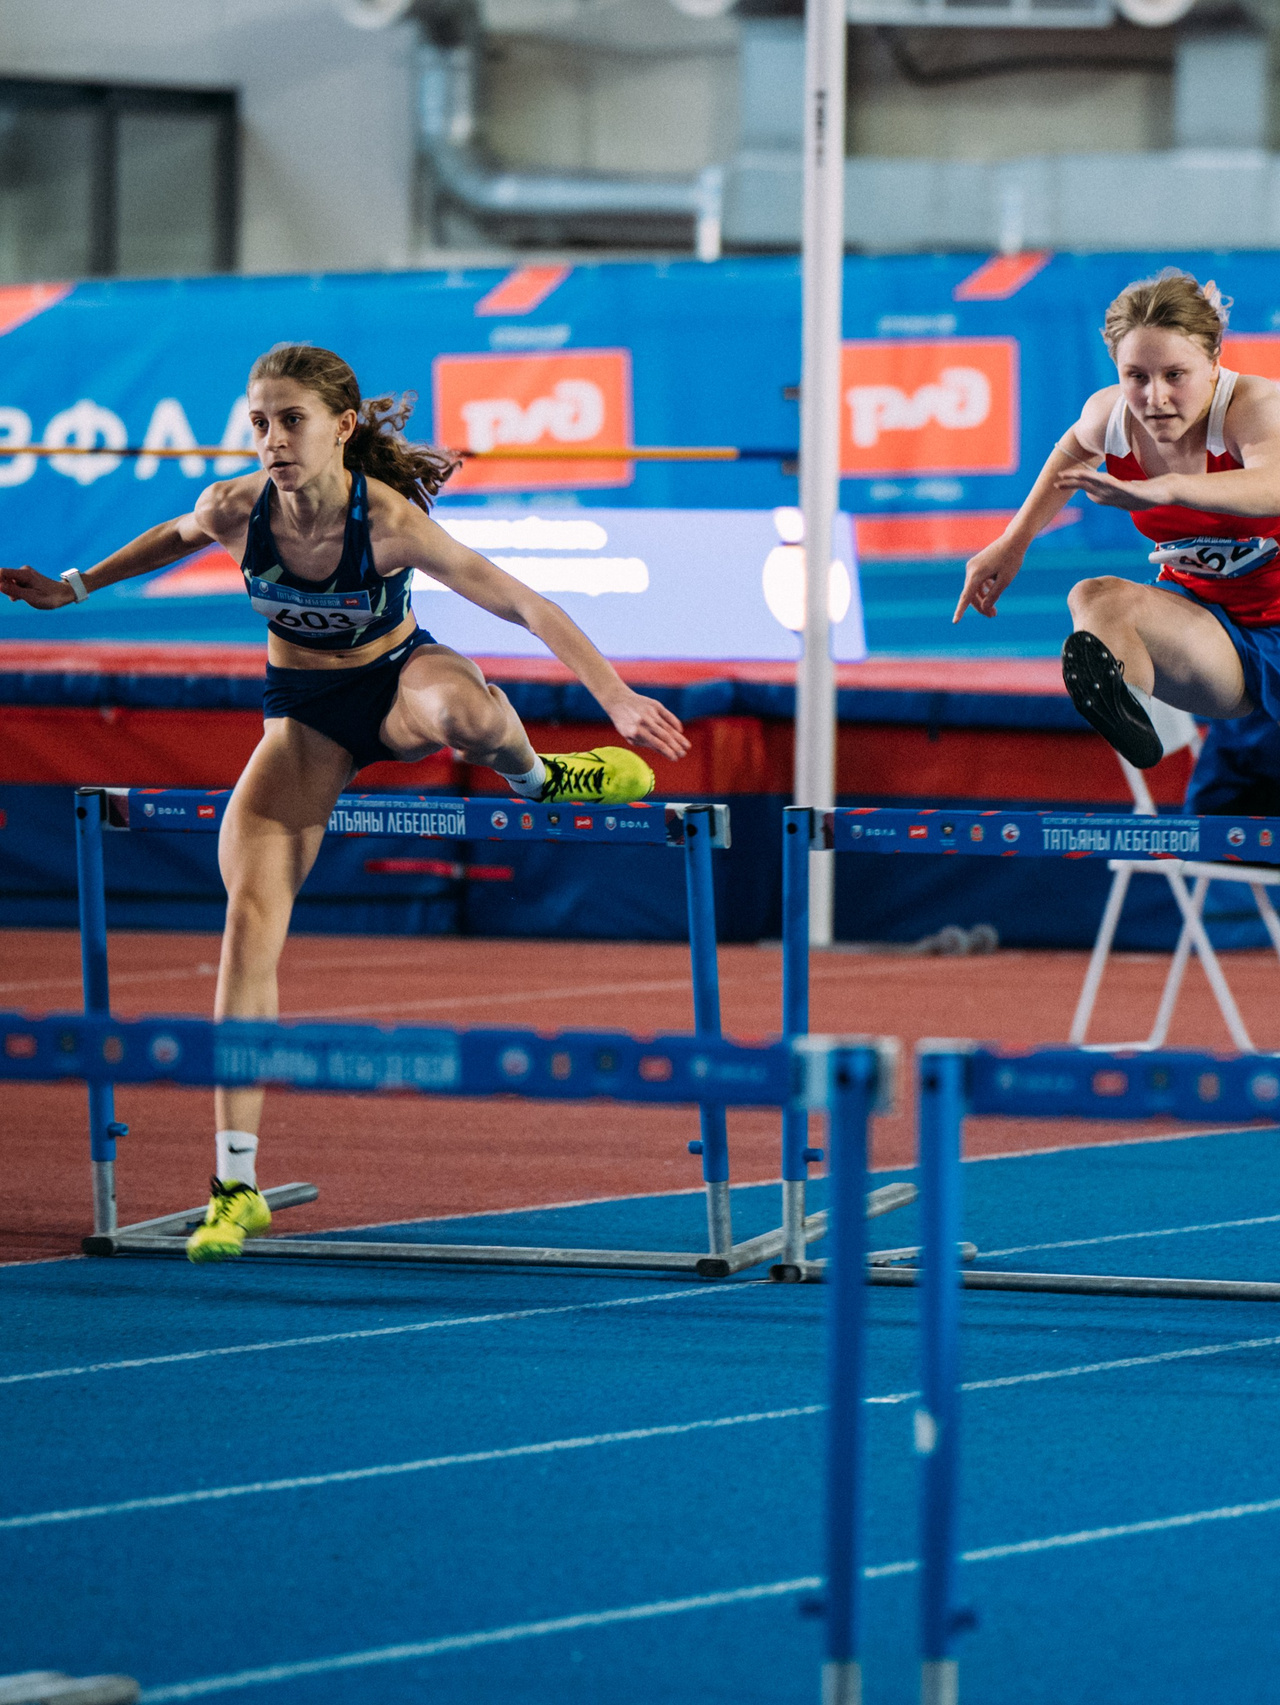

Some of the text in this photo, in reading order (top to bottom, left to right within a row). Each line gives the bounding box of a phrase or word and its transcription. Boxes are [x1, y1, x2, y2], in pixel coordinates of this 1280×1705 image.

[275, 608, 357, 630] 603
[328, 810, 466, 837] АТЬЯНЫ ЛЕБЕДЕВОЙ
[1042, 827, 1200, 854] ТАТЬЯНЫ ЛЕБЕДЕВОЙ
